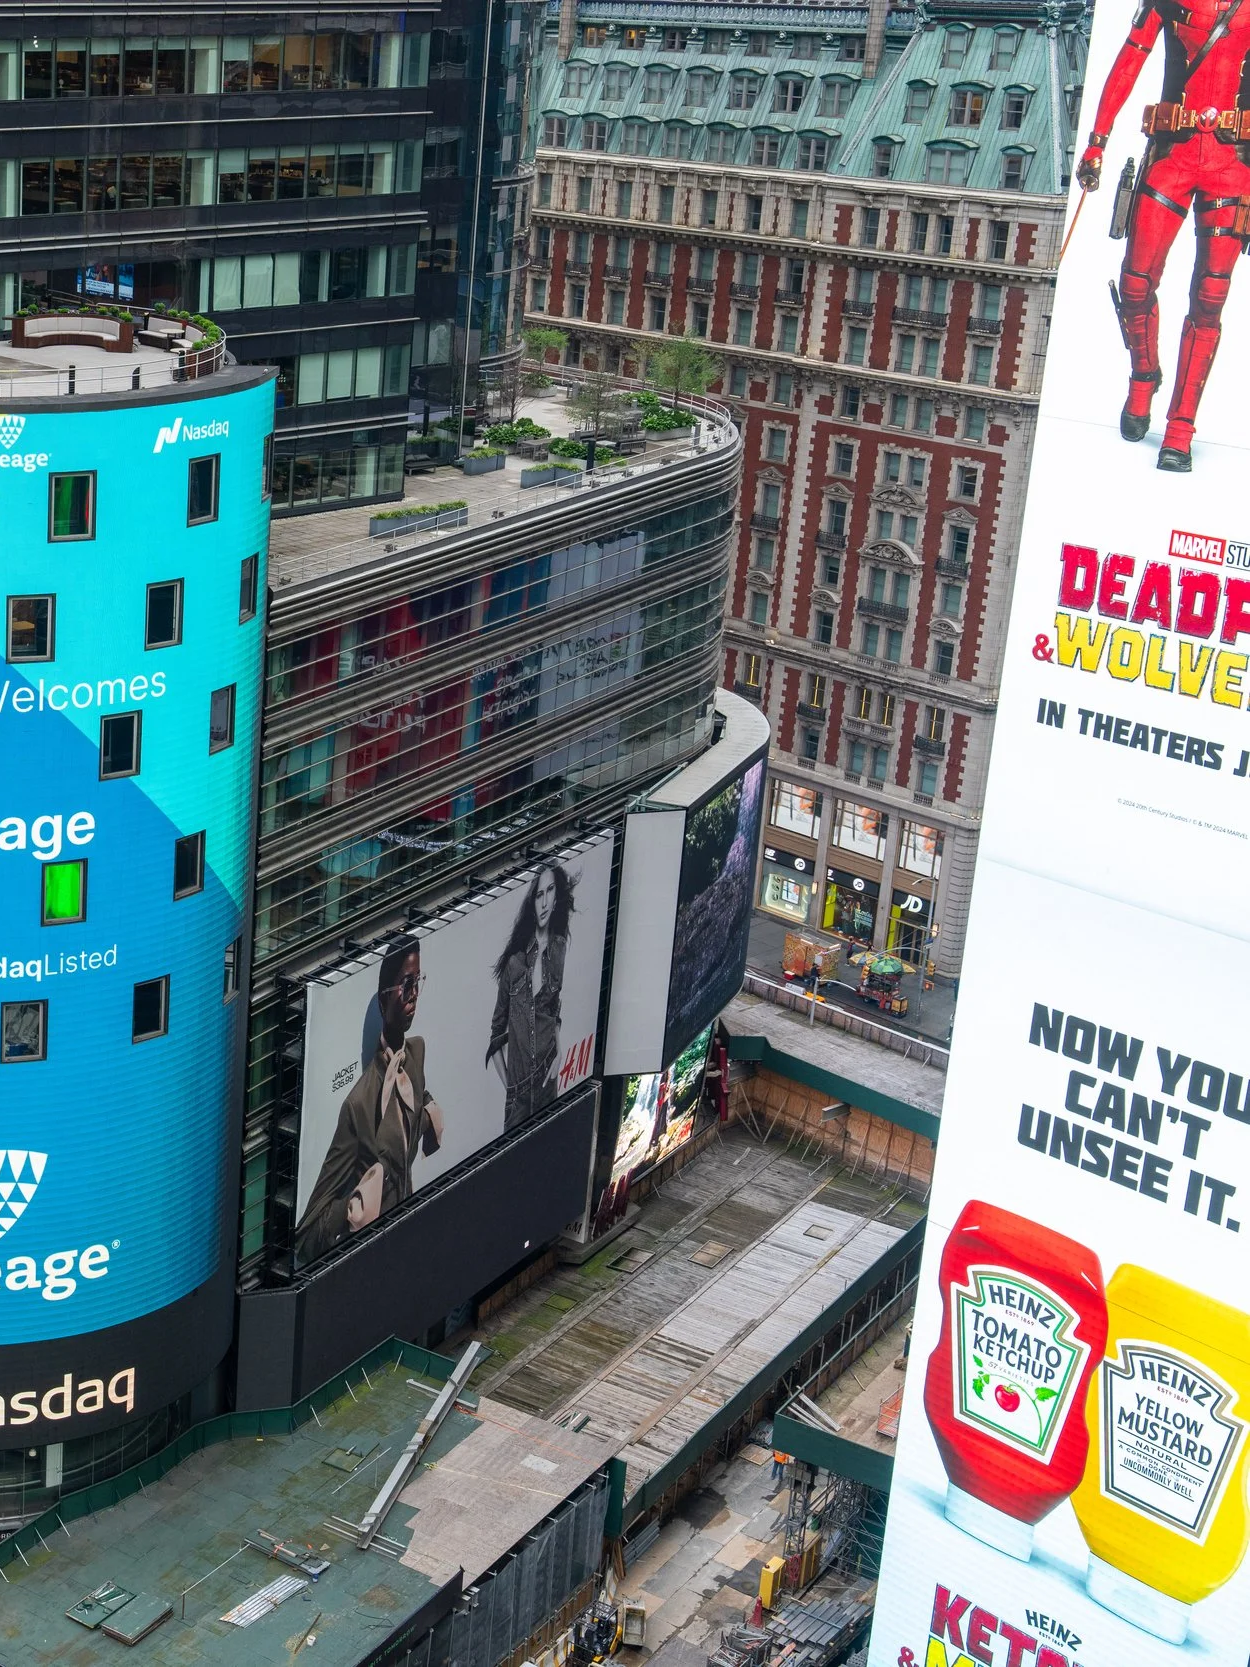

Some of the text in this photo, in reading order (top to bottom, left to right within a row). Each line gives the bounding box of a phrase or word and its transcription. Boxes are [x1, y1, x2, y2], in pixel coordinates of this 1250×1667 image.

[182, 418, 229, 443] Nasdaq
[1171, 532, 1223, 563] MARVEL
[1054, 611, 1250, 711] WOLVE
[1036, 697, 1250, 778] IN THEATERS J
[901, 894, 923, 913] JD
[331, 1060, 359, 1083] JACKET
[331, 1073, 354, 1093] $35.99
[558, 1033, 594, 1090] H&M
[1028, 1002, 1250, 1125] NOW YOU
[1064, 1069, 1212, 1160] CAN'T
[1017, 1103, 1240, 1233] UNSEE IT.
[988, 1284, 1056, 1329] HEINZ
[972, 1308, 1062, 1369] TOMATO
[973, 1333, 1055, 1384] KETCHUP
[1139, 1359, 1212, 1408] HEINZ
[1117, 1406, 1213, 1467] MUSTARD
[1135, 1392, 1204, 1438] YELLOW
[1123, 1456, 1193, 1498] UNCOMMONLY WELL
[1126, 1447, 1162, 1467] COMMON
[1161, 1463, 1203, 1488] CONDIMENT
[1135, 1440, 1187, 1471] NATURAL
[1148, 1463, 1168, 1476] DONE
[1025, 1608, 1083, 1651] HEINZ
